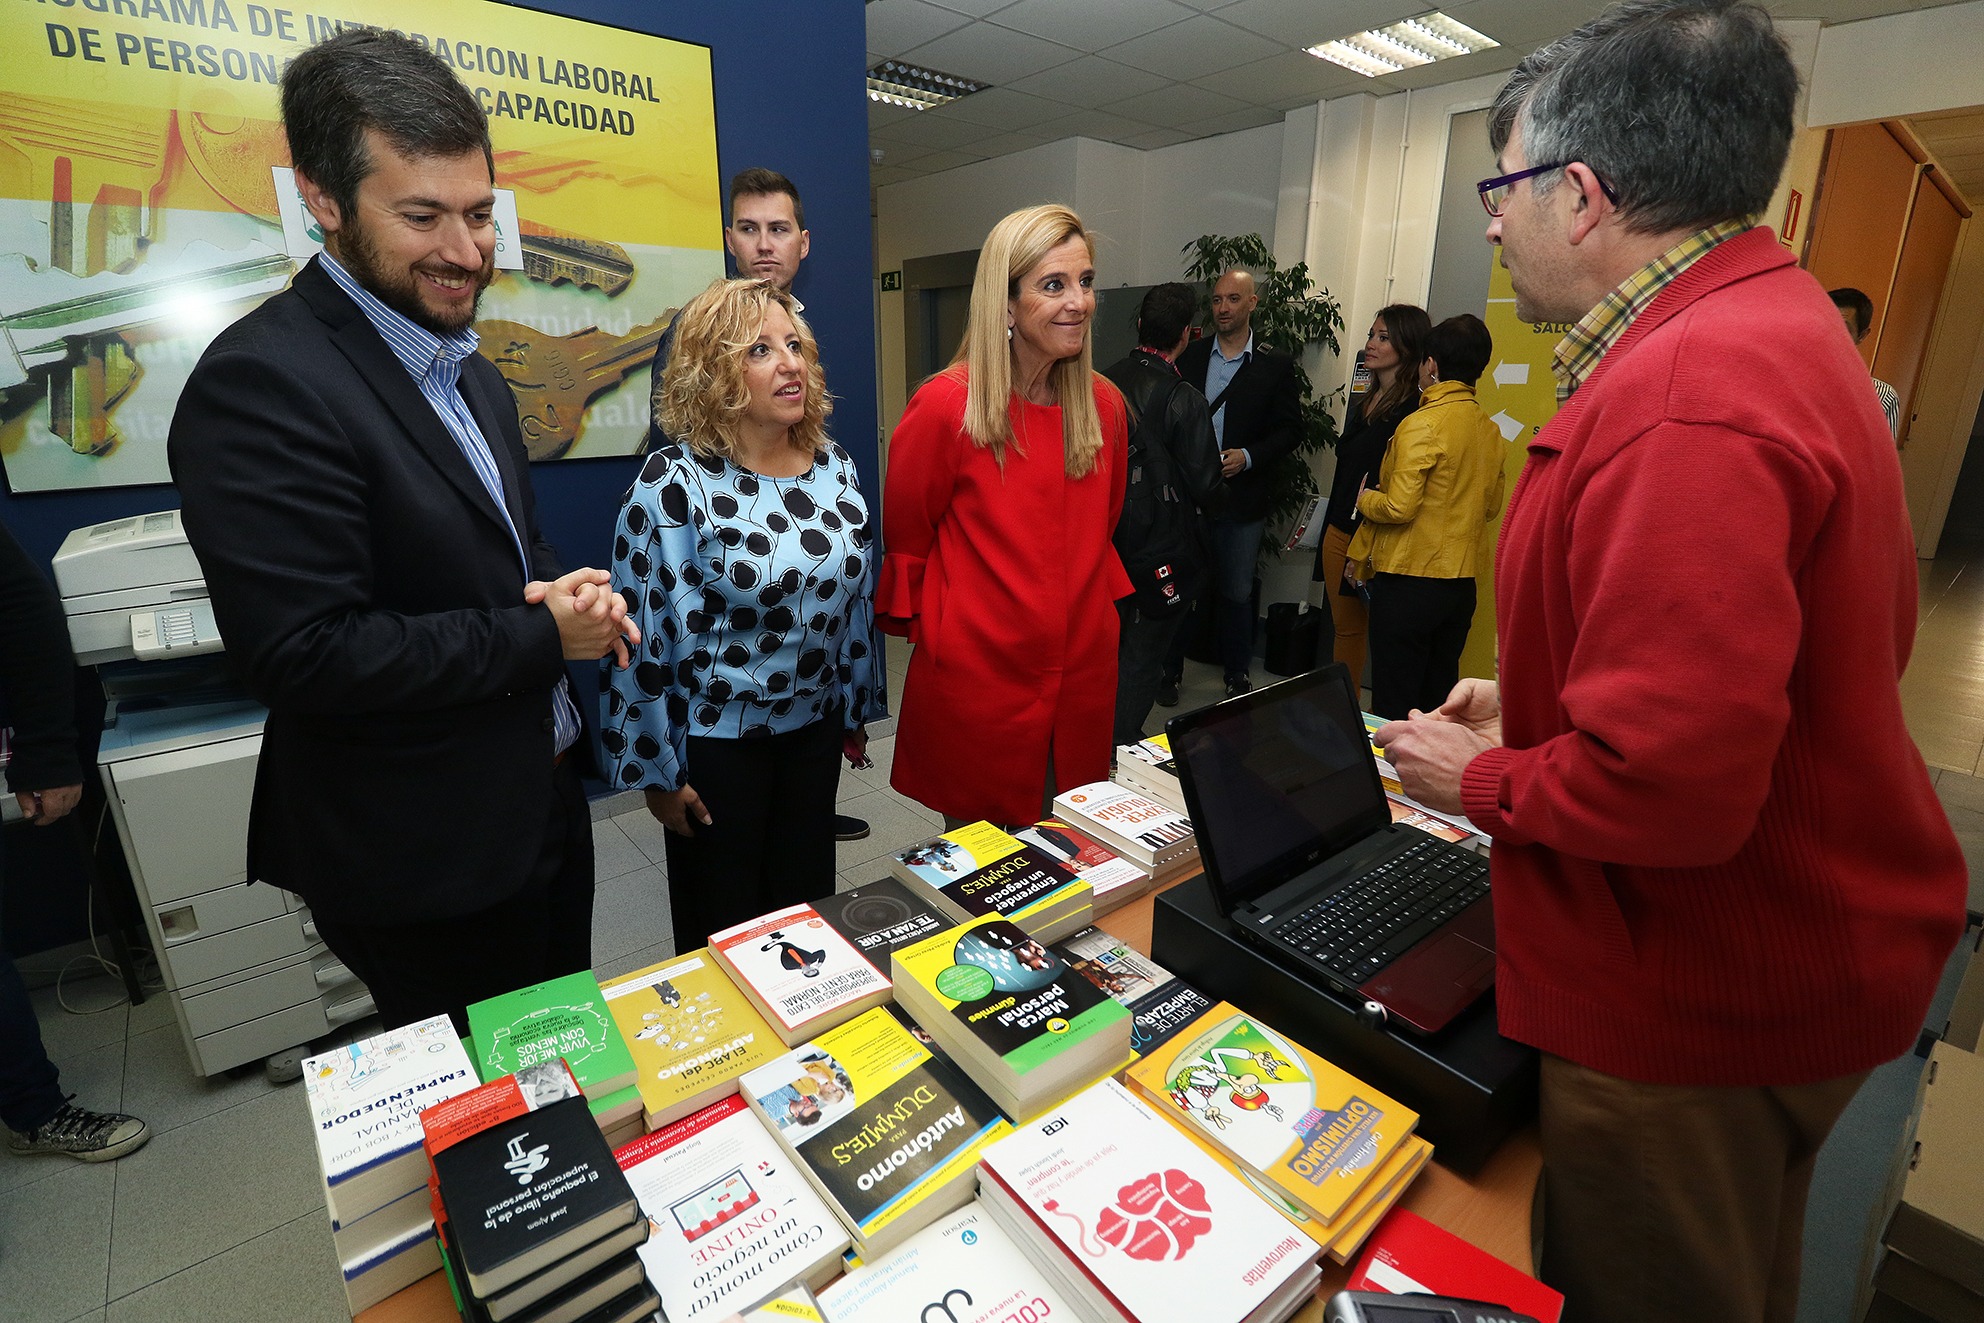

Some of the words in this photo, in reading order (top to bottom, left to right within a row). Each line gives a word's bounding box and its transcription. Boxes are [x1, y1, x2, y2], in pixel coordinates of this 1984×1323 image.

[247, 4, 298, 42] DE
[537, 55, 661, 104] LABORAL
[45, 22, 106, 63] DE
[473, 84, 636, 137] CAPACIDAD
[960, 856, 1031, 895] DUMMIES
[1028, 870, 1046, 881] un
[984, 878, 1030, 904] negocio
[995, 876, 1058, 912] Emprender
[890, 920, 919, 936] VAN
[915, 915, 935, 927] TE
[857, 932, 883, 947] OÍR
[877, 929, 894, 940] A
[904, 927, 924, 938] PÉREZ
[845, 968, 871, 981] PARA
[820, 975, 849, 992] GENTE
[822, 975, 874, 999] SUPERPODERES
[781, 986, 821, 1008] NORMAL
[809, 994, 825, 1005] DEL
[839, 988, 862, 1000] MAGO
[786, 1001, 811, 1016] ÉXITO
[967, 996, 1016, 1023] dummies
[997, 983, 1065, 1027] personal
[1016, 996, 1070, 1028] Marca
[1139, 988, 1198, 1025] EMPEZAR
[1166, 1002, 1197, 1024] ARTE
[522, 1014, 564, 1031] colaborativa
[543, 1018, 562, 1030] nueva
[553, 1017, 584, 1032] Descubre
[562, 1016, 571, 1024] la
[570, 1013, 580, 1021] de
[1150, 1018, 1173, 1033] DE
[509, 1026, 541, 1041] economía
[509, 1033, 539, 1047] ventajas
[541, 1027, 553, 1037] las
[559, 1027, 585, 1043] CON
[516, 1035, 559, 1057] MENOS
[558, 1036, 591, 1054] VIVIR
[732, 1046, 747, 1057] El
[518, 1046, 557, 1068] MEJOR
[657, 1032, 754, 1080] AUTÓNOMO
[704, 1052, 731, 1070] ABC
[744, 1051, 764, 1062] LUIS
[681, 1065, 703, 1080] del
[718, 1061, 744, 1075] PARDO
[322, 1069, 466, 1130] EMPRENDEDOR
[388, 1098, 414, 1114] DEL
[357, 1103, 428, 1139] MANUAL
[696, 1103, 730, 1123] Manuales
[1367, 1110, 1379, 1120] SER
[456, 1120, 487, 1137] edición
[685, 1119, 697, 1130] de
[831, 1085, 938, 1165] DUMMIES
[1041, 1117, 1069, 1136] ICB
[1289, 1107, 1325, 1137] TORPES
[365, 1134, 390, 1148] BOB
[391, 1128, 401, 1138] Y
[649, 1125, 687, 1147] Economía
[888, 1128, 907, 1143] PARA
[1293, 1101, 1369, 1176] OPTIMISMO
[1349, 1128, 1362, 1139] UNA
[1360, 1129, 1385, 1152] Carlos
[642, 1141, 650, 1151] y
[685, 1140, 702, 1150] Borja
[857, 1105, 966, 1191] Autónomo
[1051, 1147, 1065, 1158] Jordi
[1100, 1143, 1118, 1156] Deja
[1332, 1136, 1355, 1160] CUESTIÓN
[332, 1145, 361, 1164] DORF
[663, 1148, 687, 1164] Pascual
[1082, 1158, 1096, 1168] de
[1090, 1151, 1104, 1162] ya
[1325, 1155, 1337, 1165] DE
[1018, 1165, 1036, 1177] López
[1310, 1162, 1331, 1183] ACTITUD
[1335, 1146, 1370, 1182] Hernández
[533, 1163, 589, 1193] superación
[587, 1170, 599, 1182] El
[1064, 1165, 1084, 1181] vender
[541, 1174, 587, 1202] pequeño
[1032, 1188, 1047, 1198] que
[1046, 1181, 1061, 1192] haz
[1175, 1181, 1193, 1195] Coaching
[486, 1187, 532, 1219] personal
[514, 1198, 541, 1214] libro
[498, 1211, 513, 1223] de
[550, 1206, 568, 1221] Josef
[484, 1219, 497, 1229] la
[527, 1215, 549, 1230] Ajram
[773, 1218, 797, 1238] un
[942, 1215, 978, 1237] Pearson
[690, 1208, 777, 1266] ONLINE
[768, 1225, 823, 1264] Cómo
[693, 1236, 768, 1289] negocio
[891, 1248, 919, 1267] Adrián
[1242, 1235, 1302, 1286] Neuroventas
[858, 1263, 893, 1288] Miranda
[887, 1263, 919, 1286] Manuel
[688, 1262, 763, 1318] montar
[830, 1286, 860, 1309] Falces
[857, 1281, 887, 1305] Alonso
[1014, 1289, 1027, 1299] La
[837, 1302, 859, 1321] Coto
[988, 1296, 1015, 1316] nueva
[1001, 1297, 1051, 1323] COL
